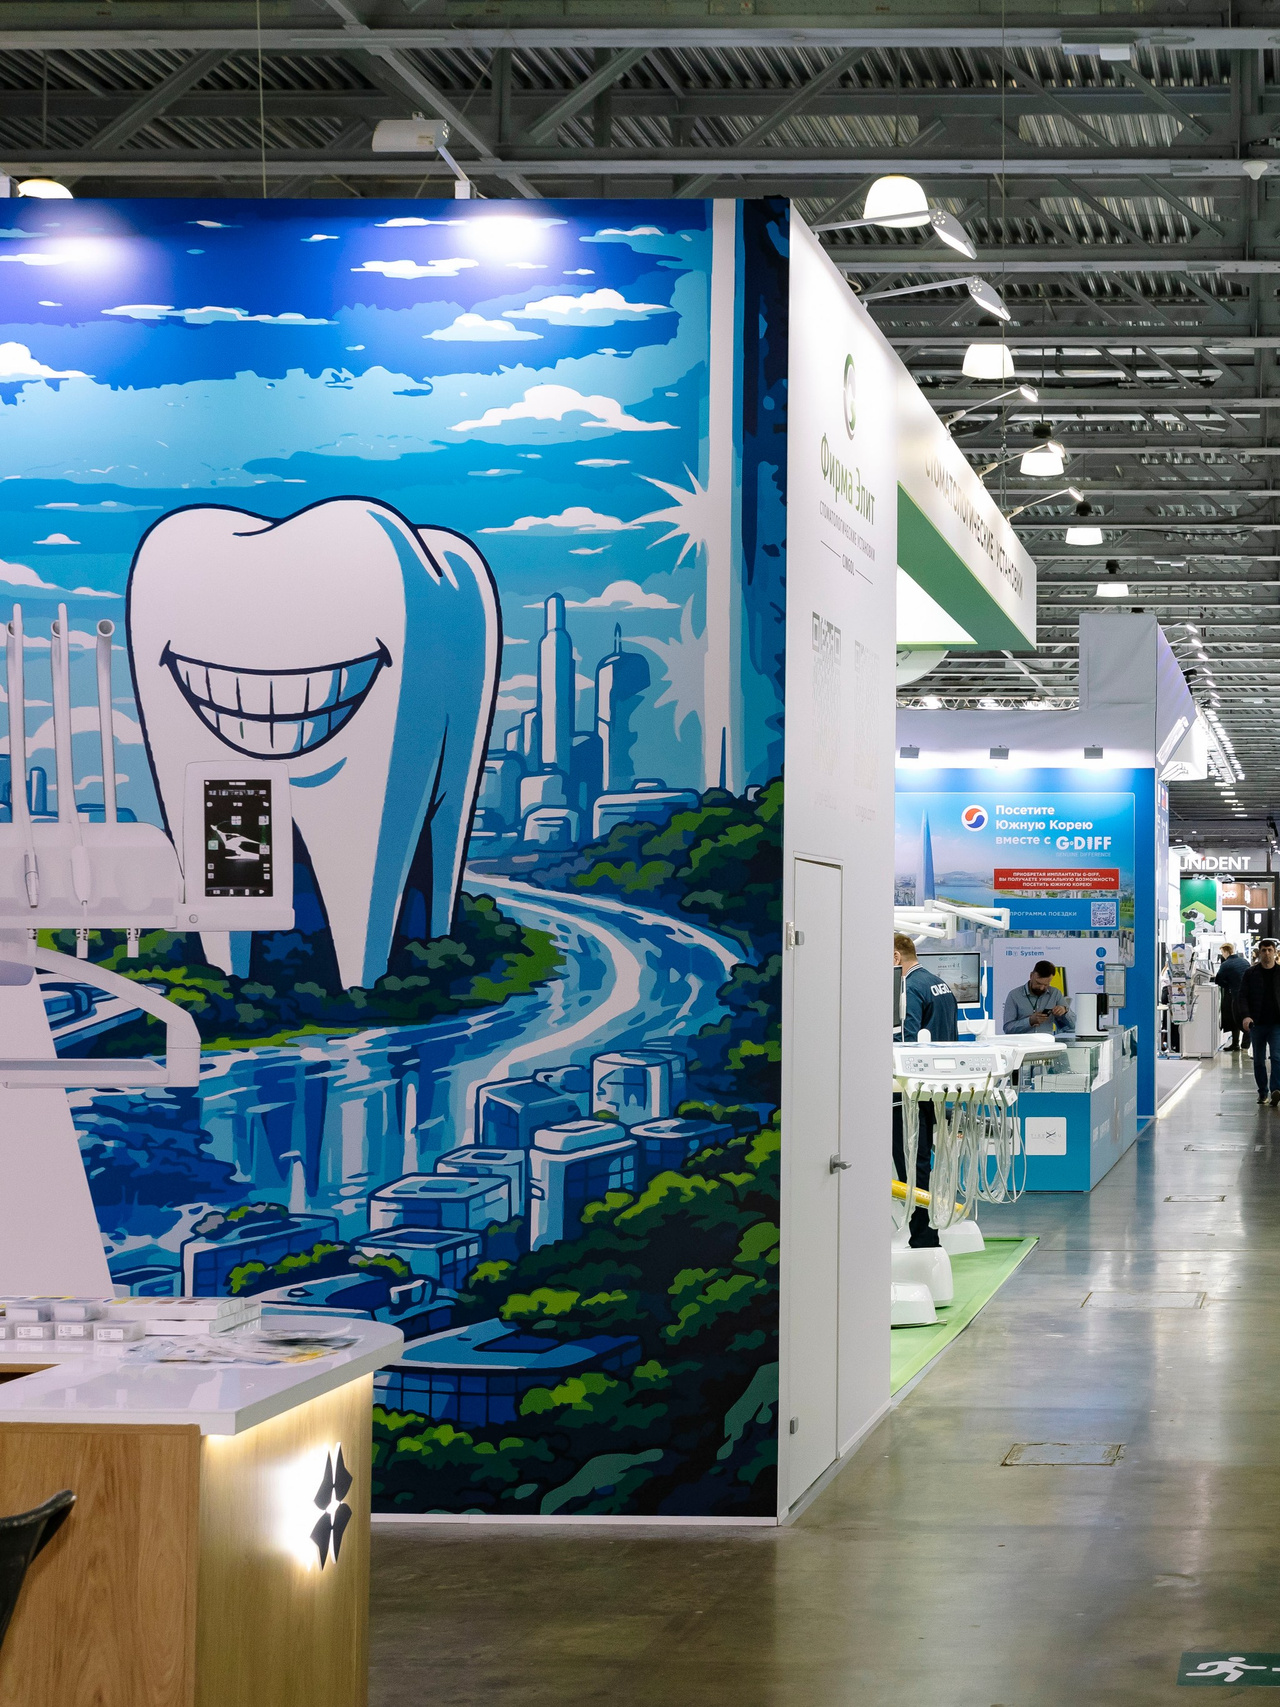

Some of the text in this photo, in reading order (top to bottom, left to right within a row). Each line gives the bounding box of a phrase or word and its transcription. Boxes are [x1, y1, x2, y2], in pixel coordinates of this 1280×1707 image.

[820, 432, 853, 504] Фирма
[995, 804, 1055, 816] Посетите
[995, 819, 1094, 832] Южную Корею
[995, 836, 1041, 845] вместе
[1043, 836, 1052, 845] с
